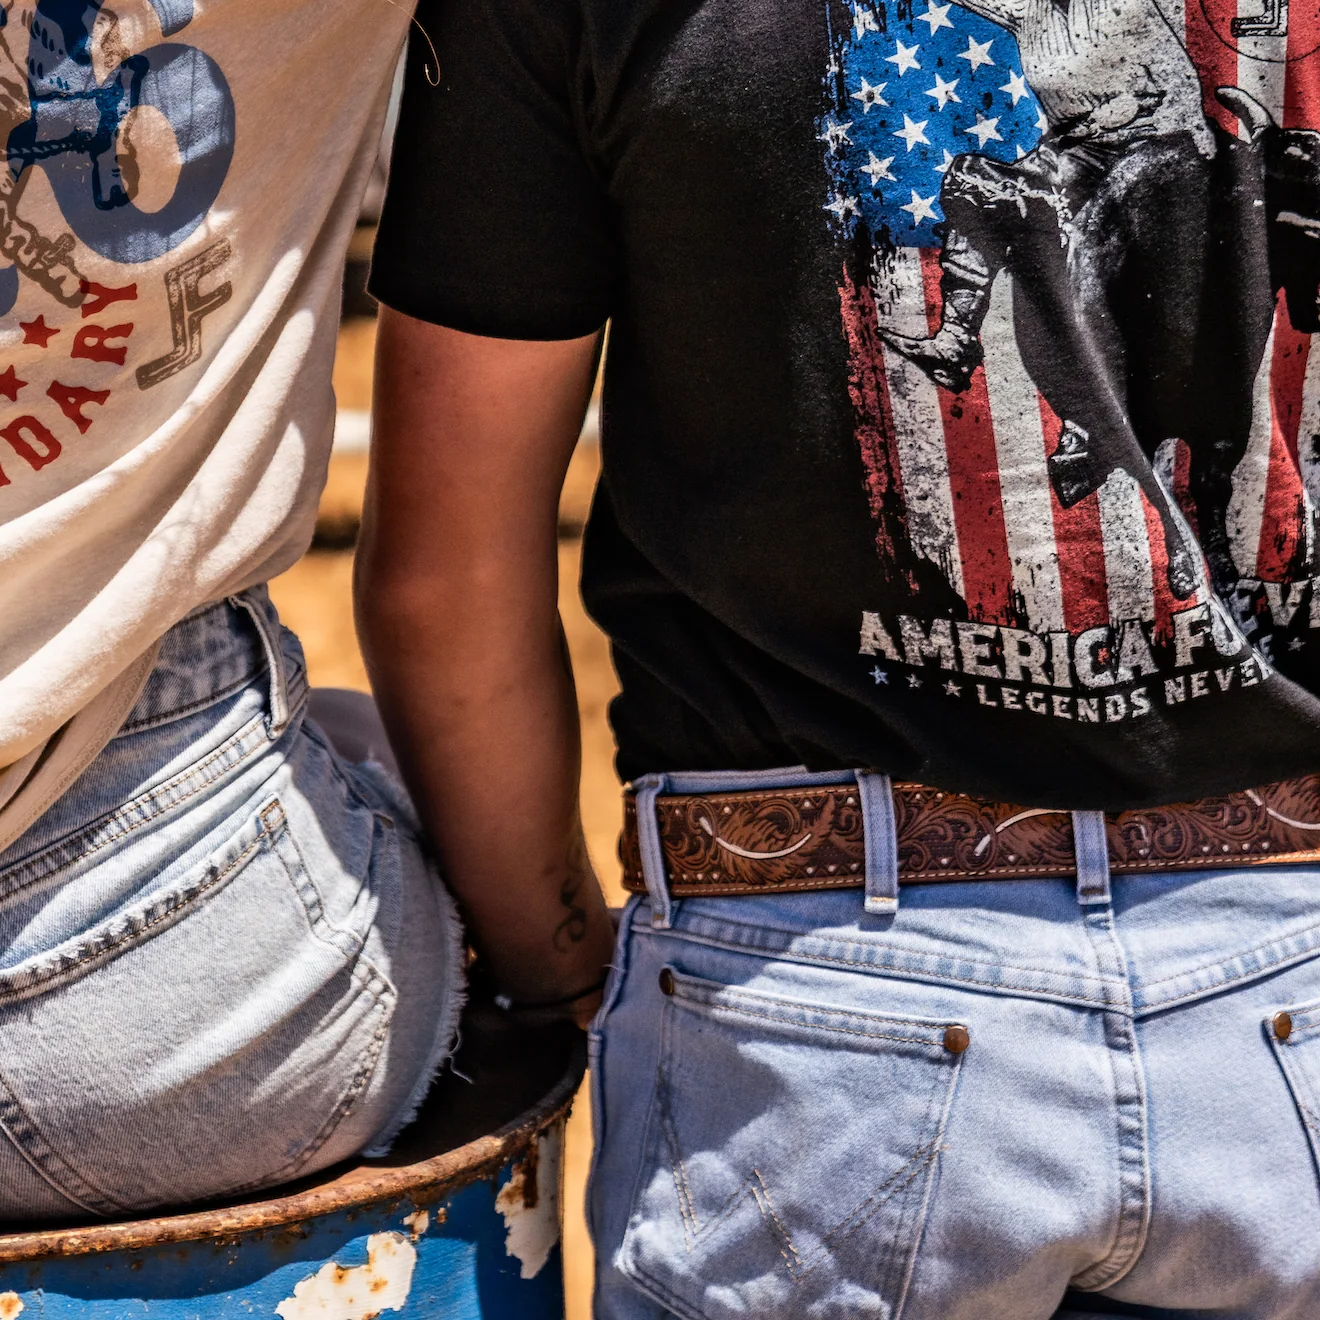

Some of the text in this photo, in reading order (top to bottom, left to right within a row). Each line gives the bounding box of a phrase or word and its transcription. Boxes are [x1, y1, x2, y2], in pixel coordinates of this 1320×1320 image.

[858, 610, 1159, 688] AMERICA
[976, 654, 1272, 723] LEGENDS NEVE
